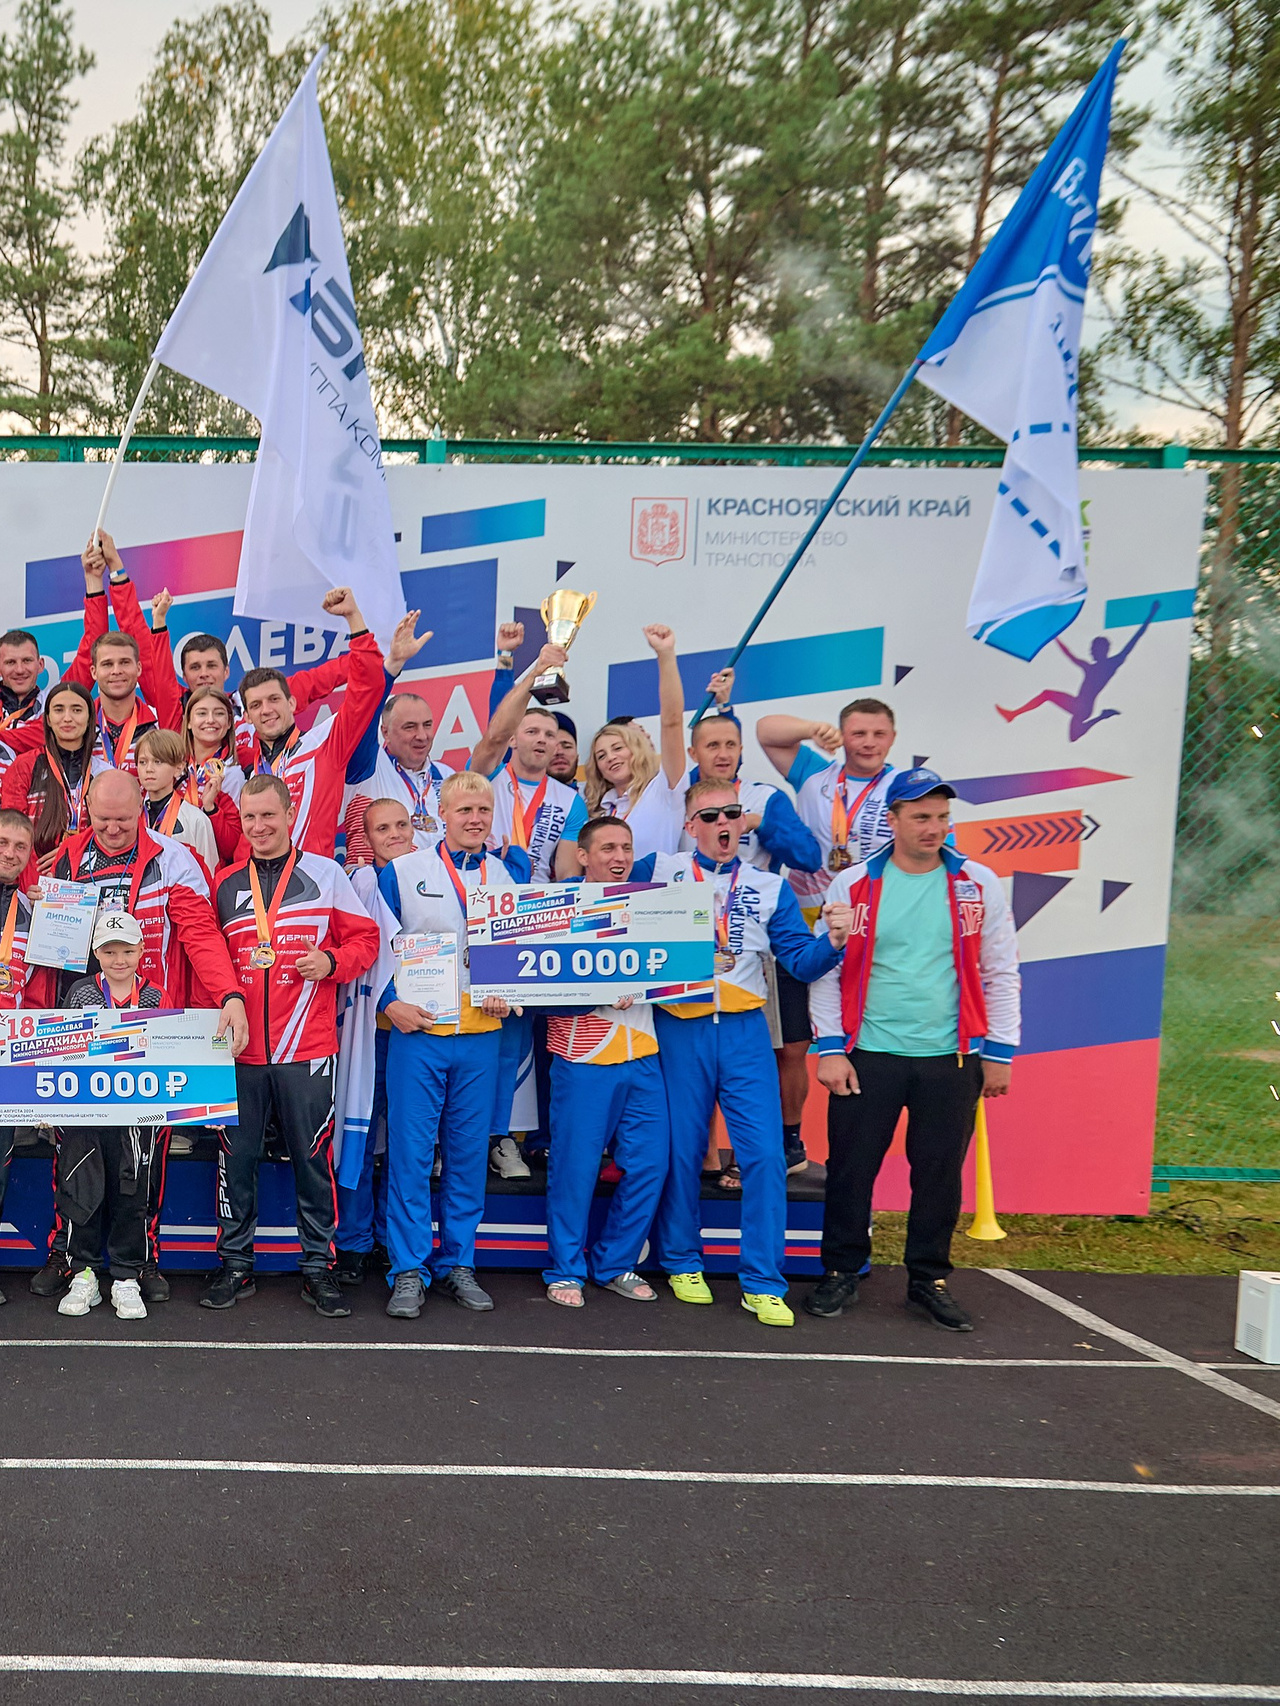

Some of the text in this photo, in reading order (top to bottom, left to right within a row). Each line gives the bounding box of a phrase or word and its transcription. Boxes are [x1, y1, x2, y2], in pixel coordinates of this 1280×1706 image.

[907, 495, 971, 517] КРАЙ
[705, 530, 848, 547] МИНИСТЕРТВО
[705, 551, 817, 569] ТРАНСПОА
[46, 882, 59, 893] 18
[487, 892, 515, 918] 18
[517, 897, 566, 912] ОТРАСЛЕВАЯ
[45, 911, 83, 925] ДИПЛОМ
[492, 908, 576, 931] СПАРТАКИАДА
[402, 938, 415, 950] 18
[517, 949, 562, 978] 20
[571, 948, 640, 977] 000
[407, 968, 445, 977] ДИПЛОМ
[7, 1016, 35, 1040] 18
[37, 1022, 84, 1035] ОТРАСЛЕВАЯ
[12, 1032, 94, 1053] СПАРТАКИАДА
[35, 1071, 80, 1098] 50
[89, 1071, 160, 1098] 000
